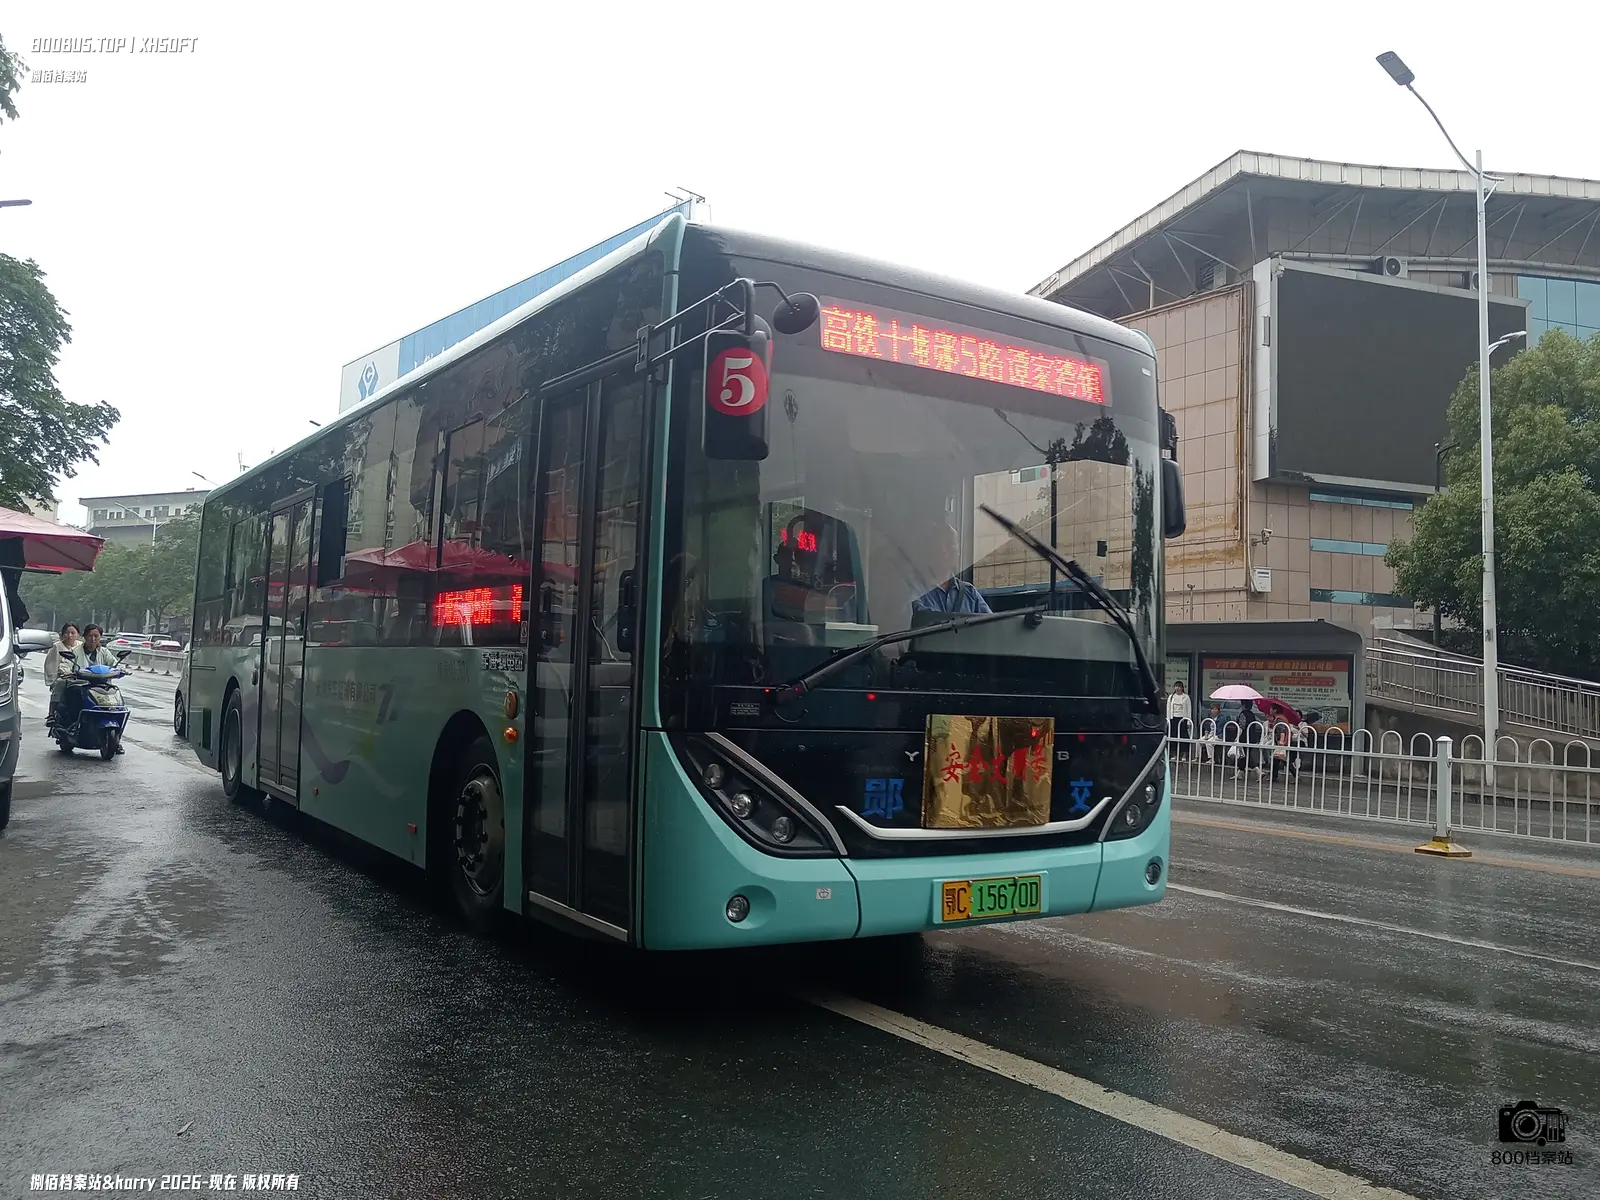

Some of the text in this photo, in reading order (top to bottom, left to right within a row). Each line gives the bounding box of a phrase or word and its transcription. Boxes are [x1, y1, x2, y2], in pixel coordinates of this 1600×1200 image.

[720, 357, 755, 407] 5
[861, 777, 1094, 819] 郧 交
